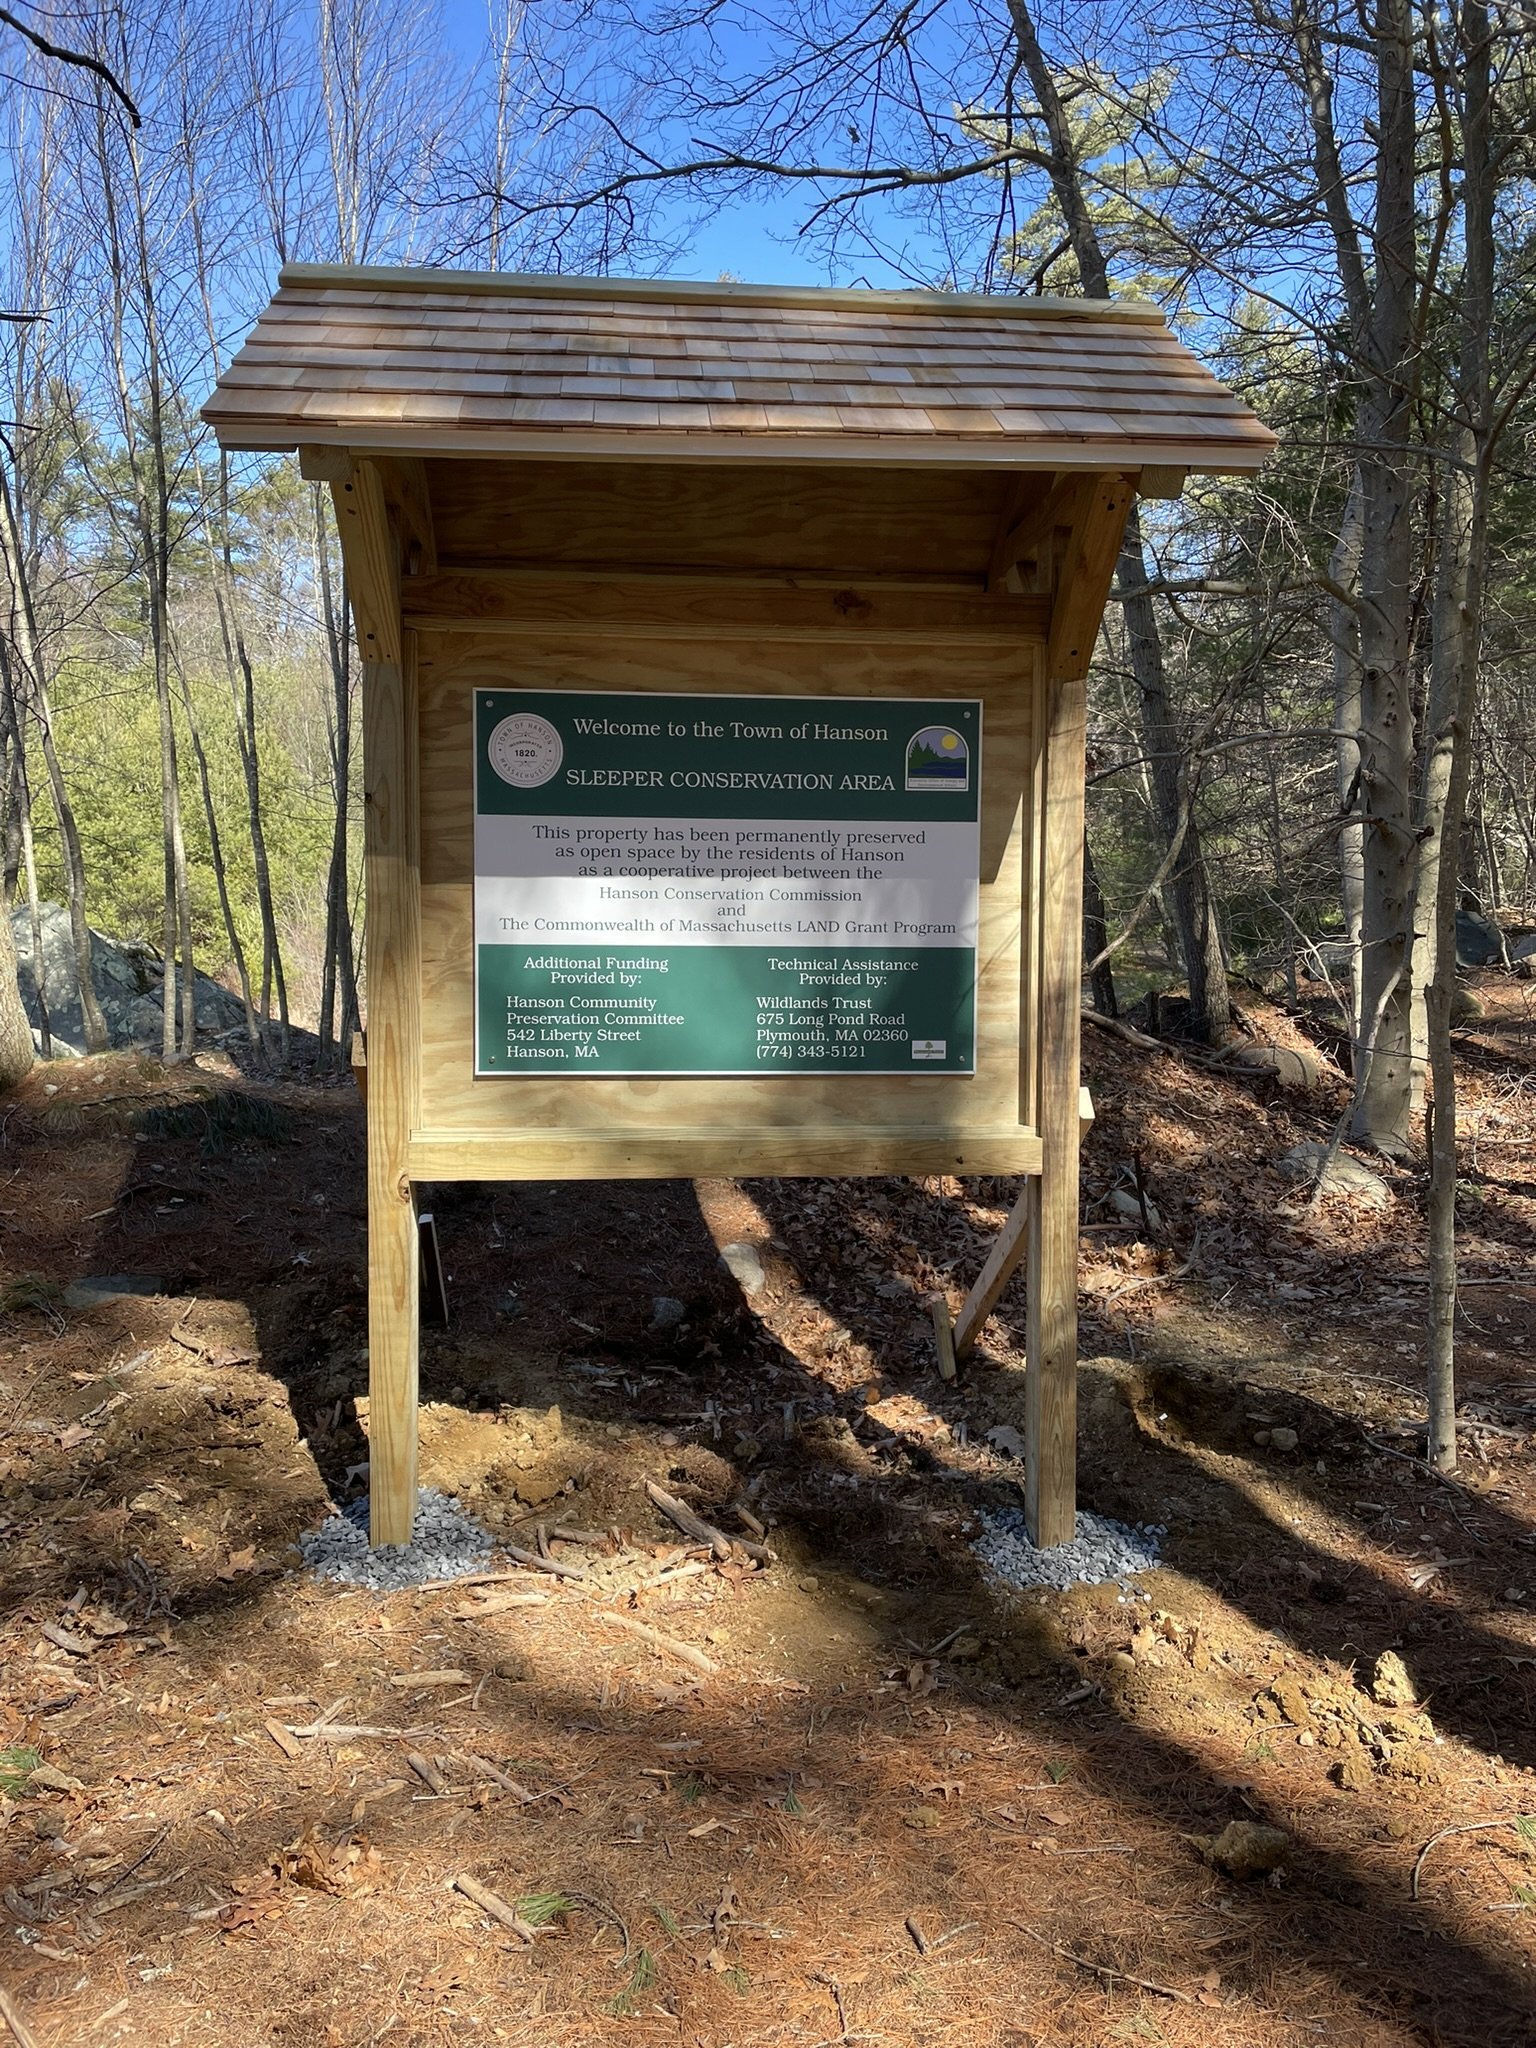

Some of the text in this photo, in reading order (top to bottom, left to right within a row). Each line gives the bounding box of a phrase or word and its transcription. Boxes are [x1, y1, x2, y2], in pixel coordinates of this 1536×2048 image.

[498, 728, 513, 745] TOWN
[528, 723, 552, 745] HANSON
[573, 719, 888, 740] Welcome to the Town of Hanson
[567, 769, 895, 790] SLEEPER CONSERVATION AREA
[532, 825, 925, 847] This property has been permanently preserved
[555, 845, 904, 863] as open space by the residents of Hanson
[579, 865, 882, 882] as a cooperative project between the
[600, 887, 861, 901] Hanson Conservation Commission
[718, 904, 745, 916] and
[499, 918, 955, 937] The Commonwealth of Massachusetts LAND Grant Program
[524, 957, 668, 973] Additional Funding
[768, 958, 918, 970] Technical Assistance
[551, 972, 641, 987] Provided by:
[800, 973, 886, 988] Provided by:
[507, 996, 657, 1011] Hanson Community
[756, 997, 872, 1008] Wildlands Trust
[507, 1013, 684, 1024] Preservation Committee
[757, 1013, 905, 1028] 675 Long Pond Road
[507, 1029, 641, 1044] 542 Liberty Street
[757, 1029, 908, 1044] Plymouth, MA 02360
[507, 1046, 599, 1058] Hanson, MA
[757, 1045, 864, 1059] (774) 343-5121
